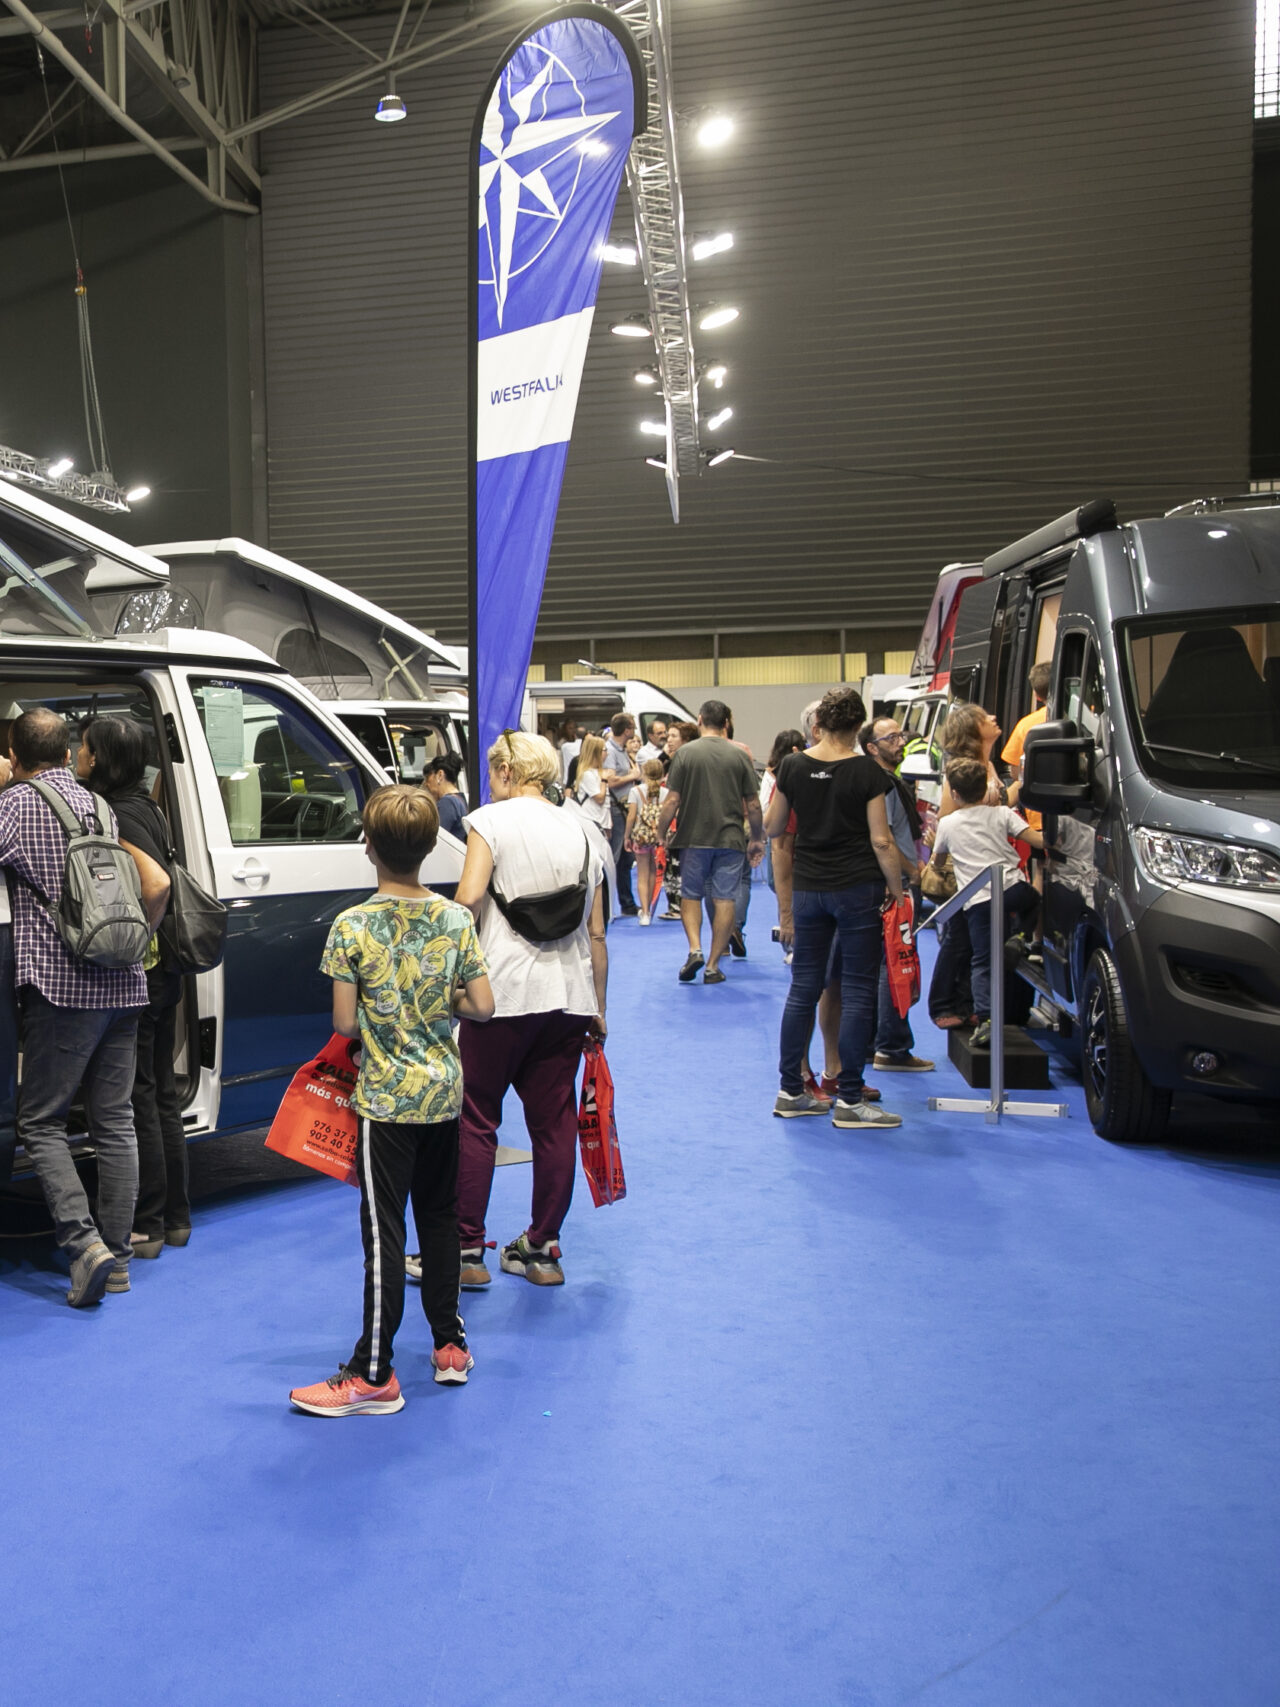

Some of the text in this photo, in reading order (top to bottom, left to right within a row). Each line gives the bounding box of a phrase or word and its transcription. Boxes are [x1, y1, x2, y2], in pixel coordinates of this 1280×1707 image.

[305, 1083, 331, 1100] más
[309, 1129, 328, 1142] 902
[330, 1138, 343, 1149] 40
[313, 1120, 331, 1134] 976
[333, 1128, 347, 1140] 37
